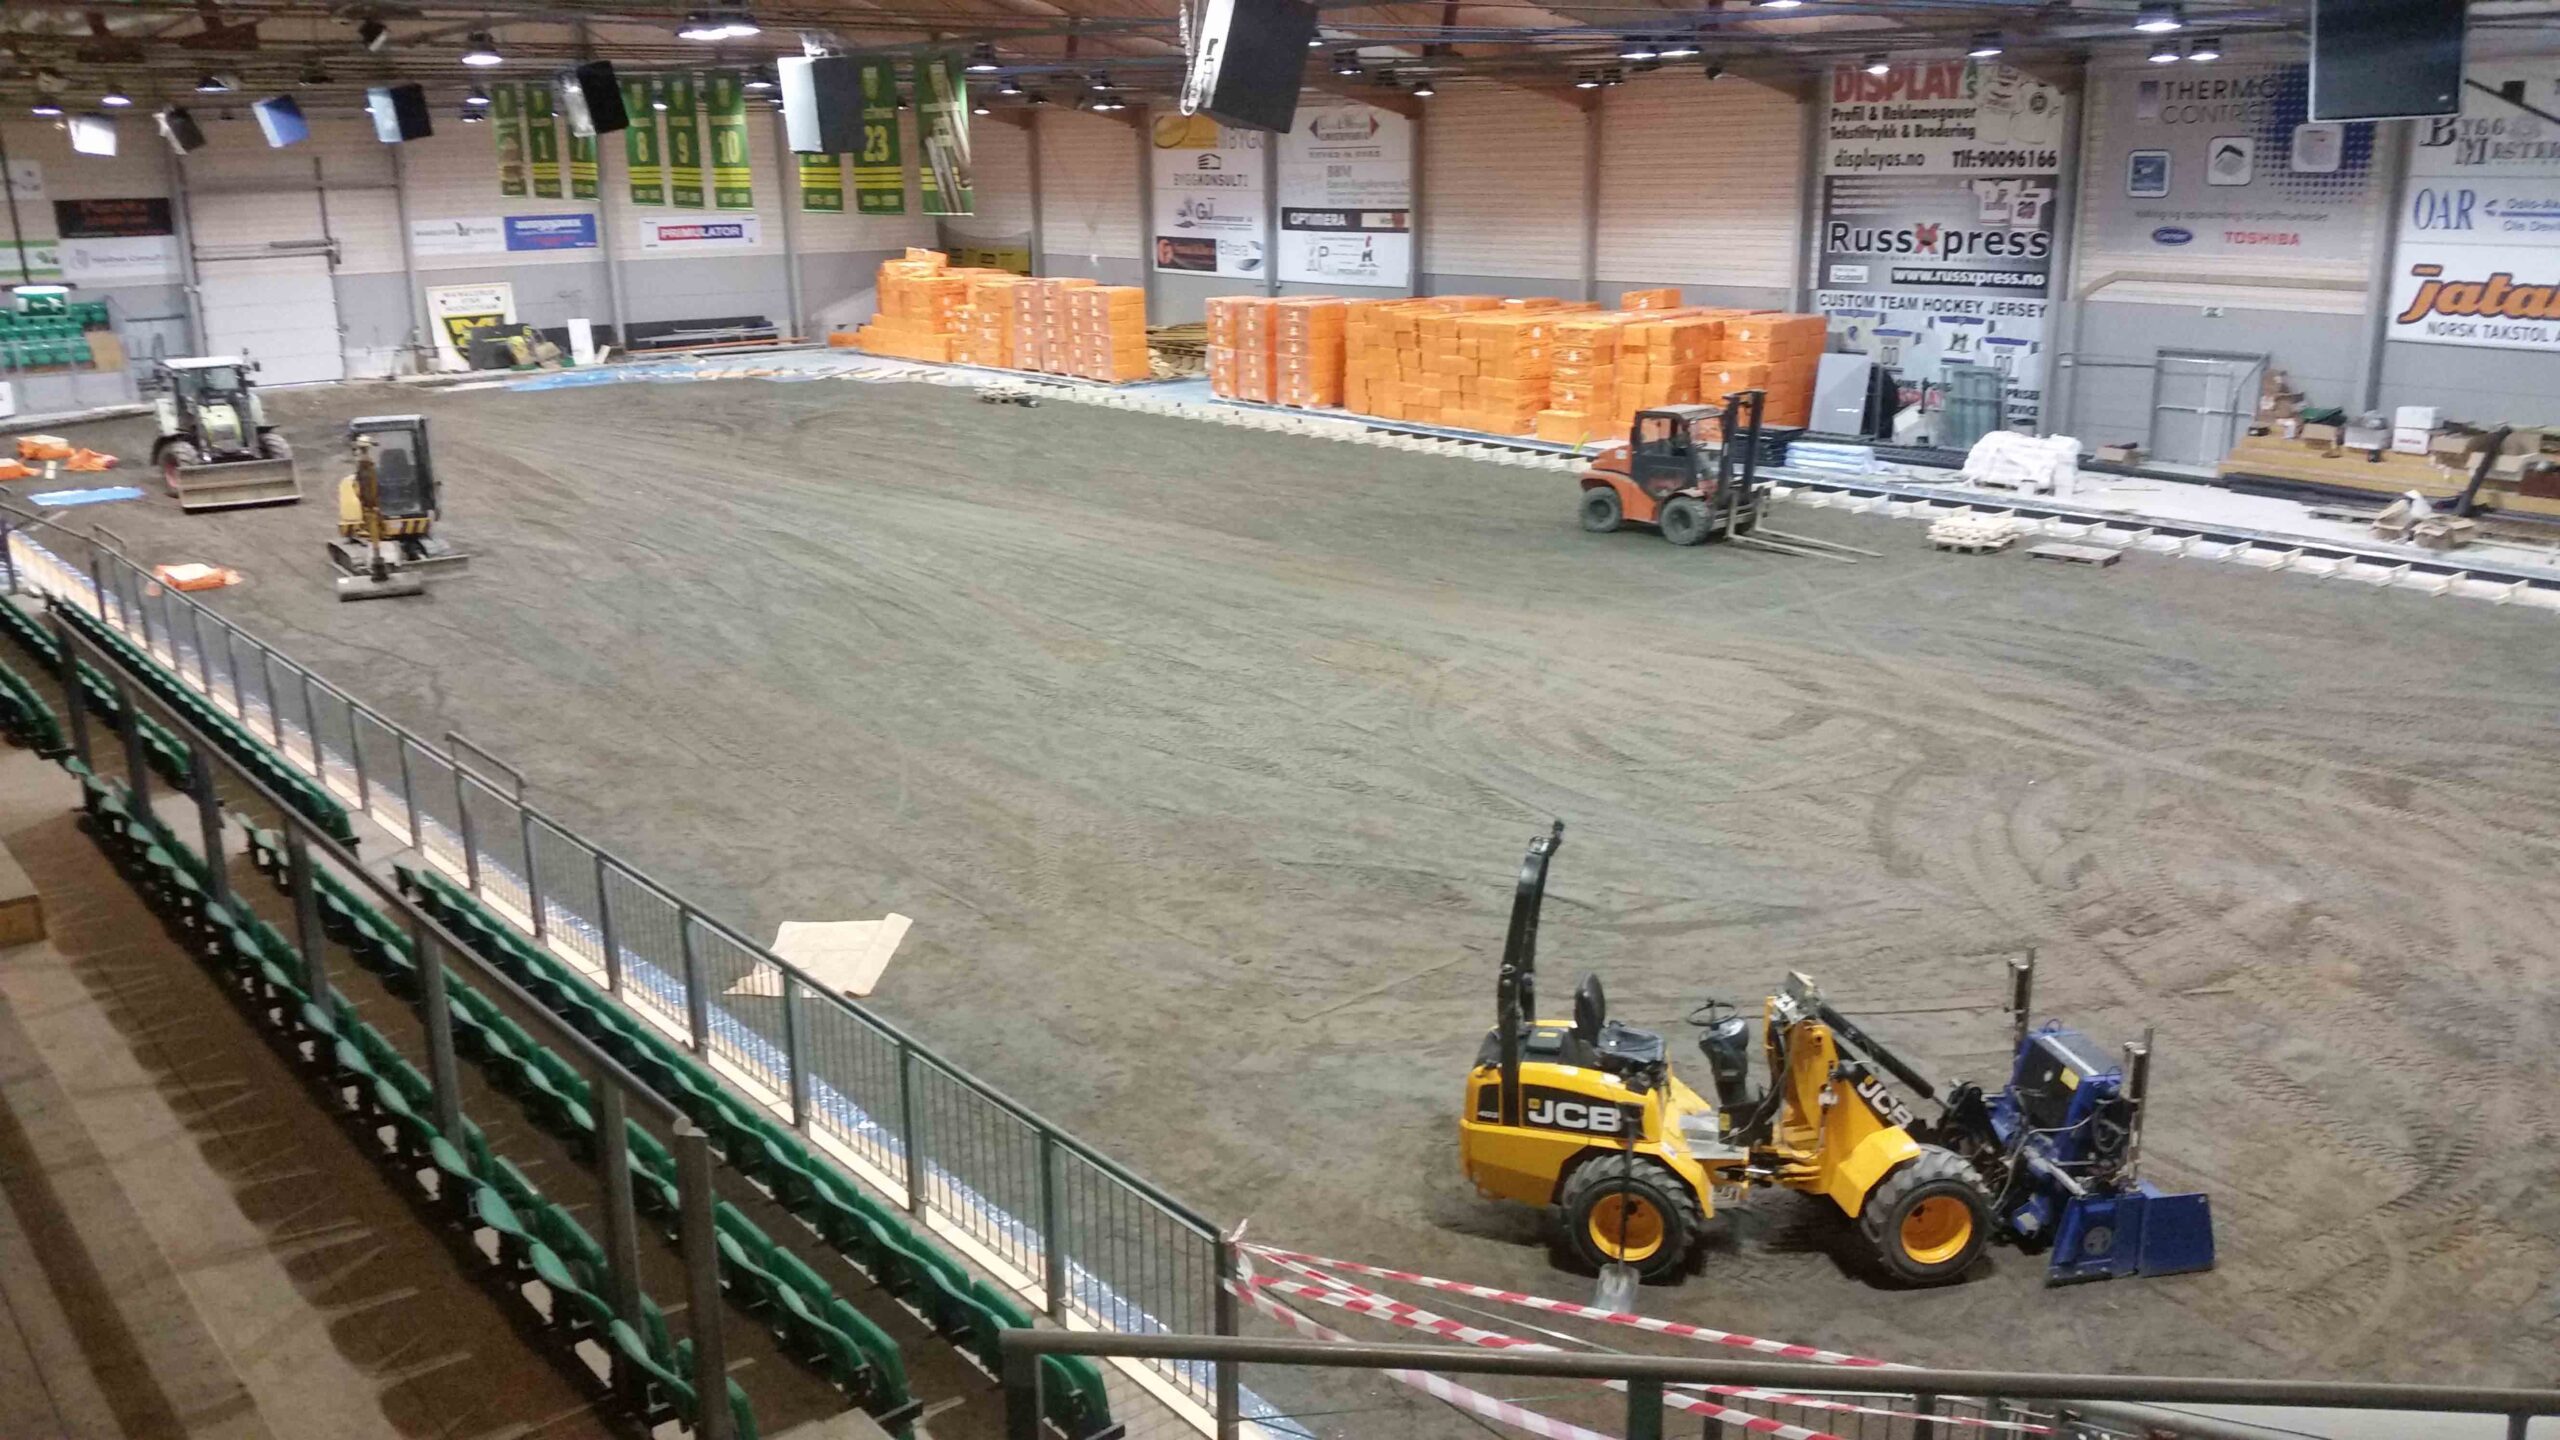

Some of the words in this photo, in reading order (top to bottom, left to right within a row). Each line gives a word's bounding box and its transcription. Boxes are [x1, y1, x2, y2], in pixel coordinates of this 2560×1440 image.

[1834, 60, 1965, 102] DISPLAY
[2165, 78, 2278, 100] THERMO
[1831, 106, 1865, 121] Profil
[1868, 107, 1878, 120] &
[1882, 105, 1977, 123] Reklamegaver
[636, 131, 649, 162] 8
[676, 131, 689, 163] 9
[718, 130, 741, 163] 10
[863, 124, 890, 162] 23
[1830, 125, 1897, 141] Tekstiltrykk
[1901, 125, 1910, 138] &
[1915, 122, 1976, 140] Brodering
[1834, 148, 1925, 171] displayas.no
[1952, 150, 2057, 168] Tlf:90096166
[2413, 187, 2476, 230] OAR
[659, 225, 742, 241] PRIMULATOR
[1829, 221, 2050, 261] RussXpress
[2225, 231, 2302, 246] TOSHIBA
[1893, 268, 2045, 287] www.russxpress.no
[1819, 293, 1875, 308] CUSTOM
[1880, 296, 1918, 310] TEAM
[1922, 298, 1984, 313] HOCKEY
[1987, 302, 2048, 319] JERSEY
[2396, 263, 2560, 324] jata
[2426, 321, 2478, 337] NORSK
[2482, 323, 2548, 342] TAKSTOL
[1528, 1099, 1621, 1132] JCB
[1857, 1081, 1914, 1130] JCB
